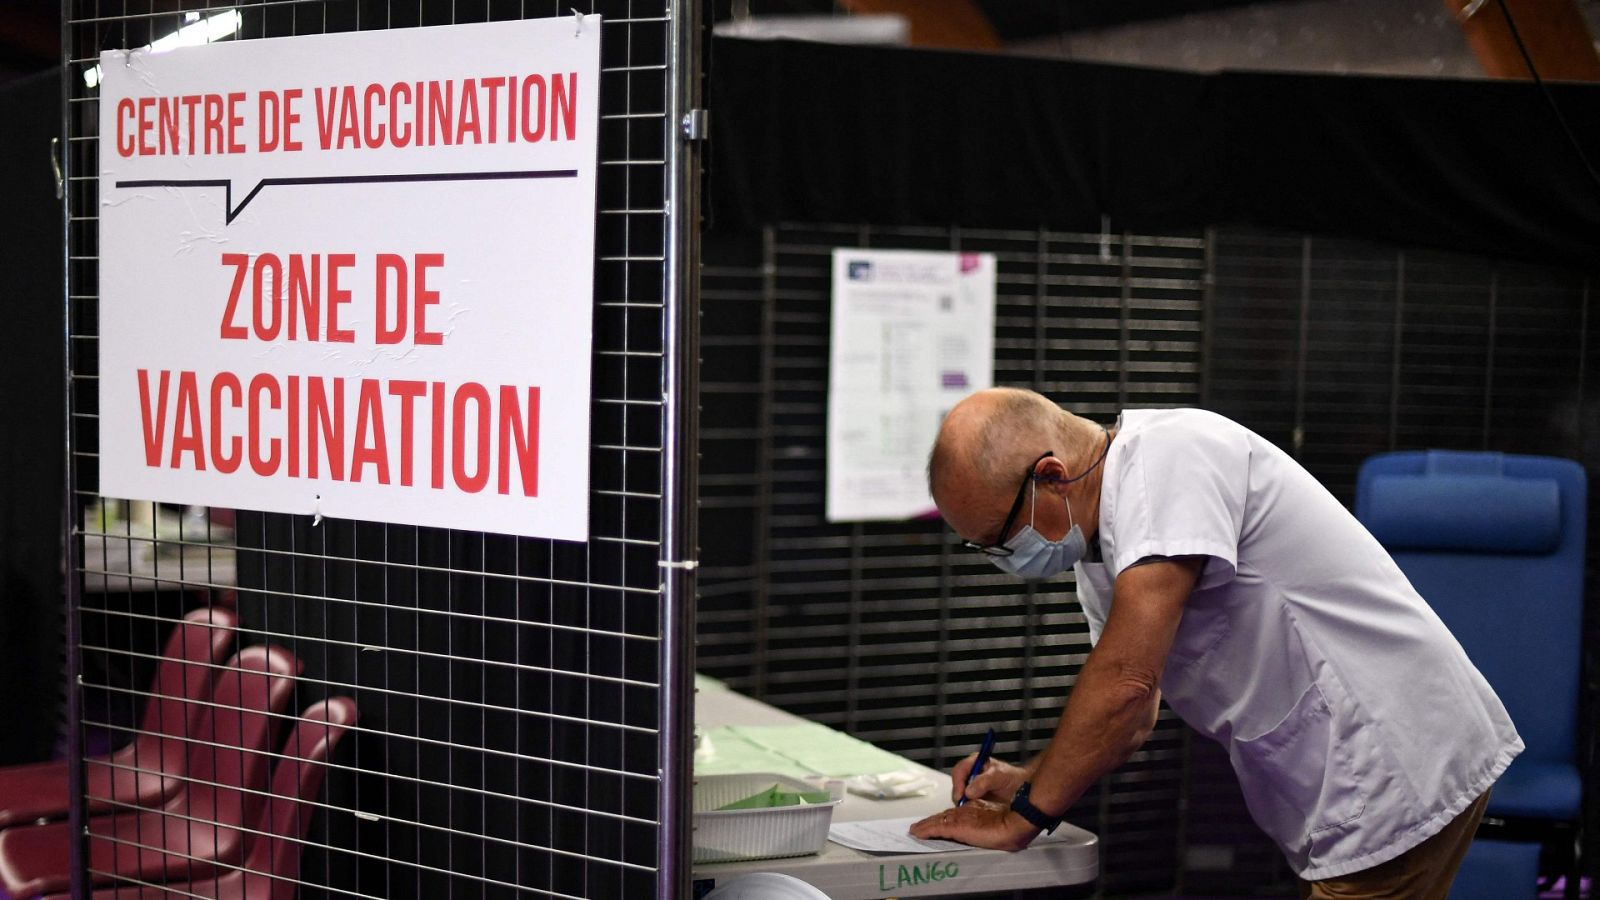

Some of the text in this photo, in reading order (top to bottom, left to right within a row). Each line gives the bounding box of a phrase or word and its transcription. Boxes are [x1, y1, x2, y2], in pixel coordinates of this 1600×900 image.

[117, 73, 578, 157] CENTRE DE VACCINATION
[221, 253, 445, 345] ZONE DE
[137, 369, 541, 497] VACCINATION
[879, 861, 960, 891] LANGO
